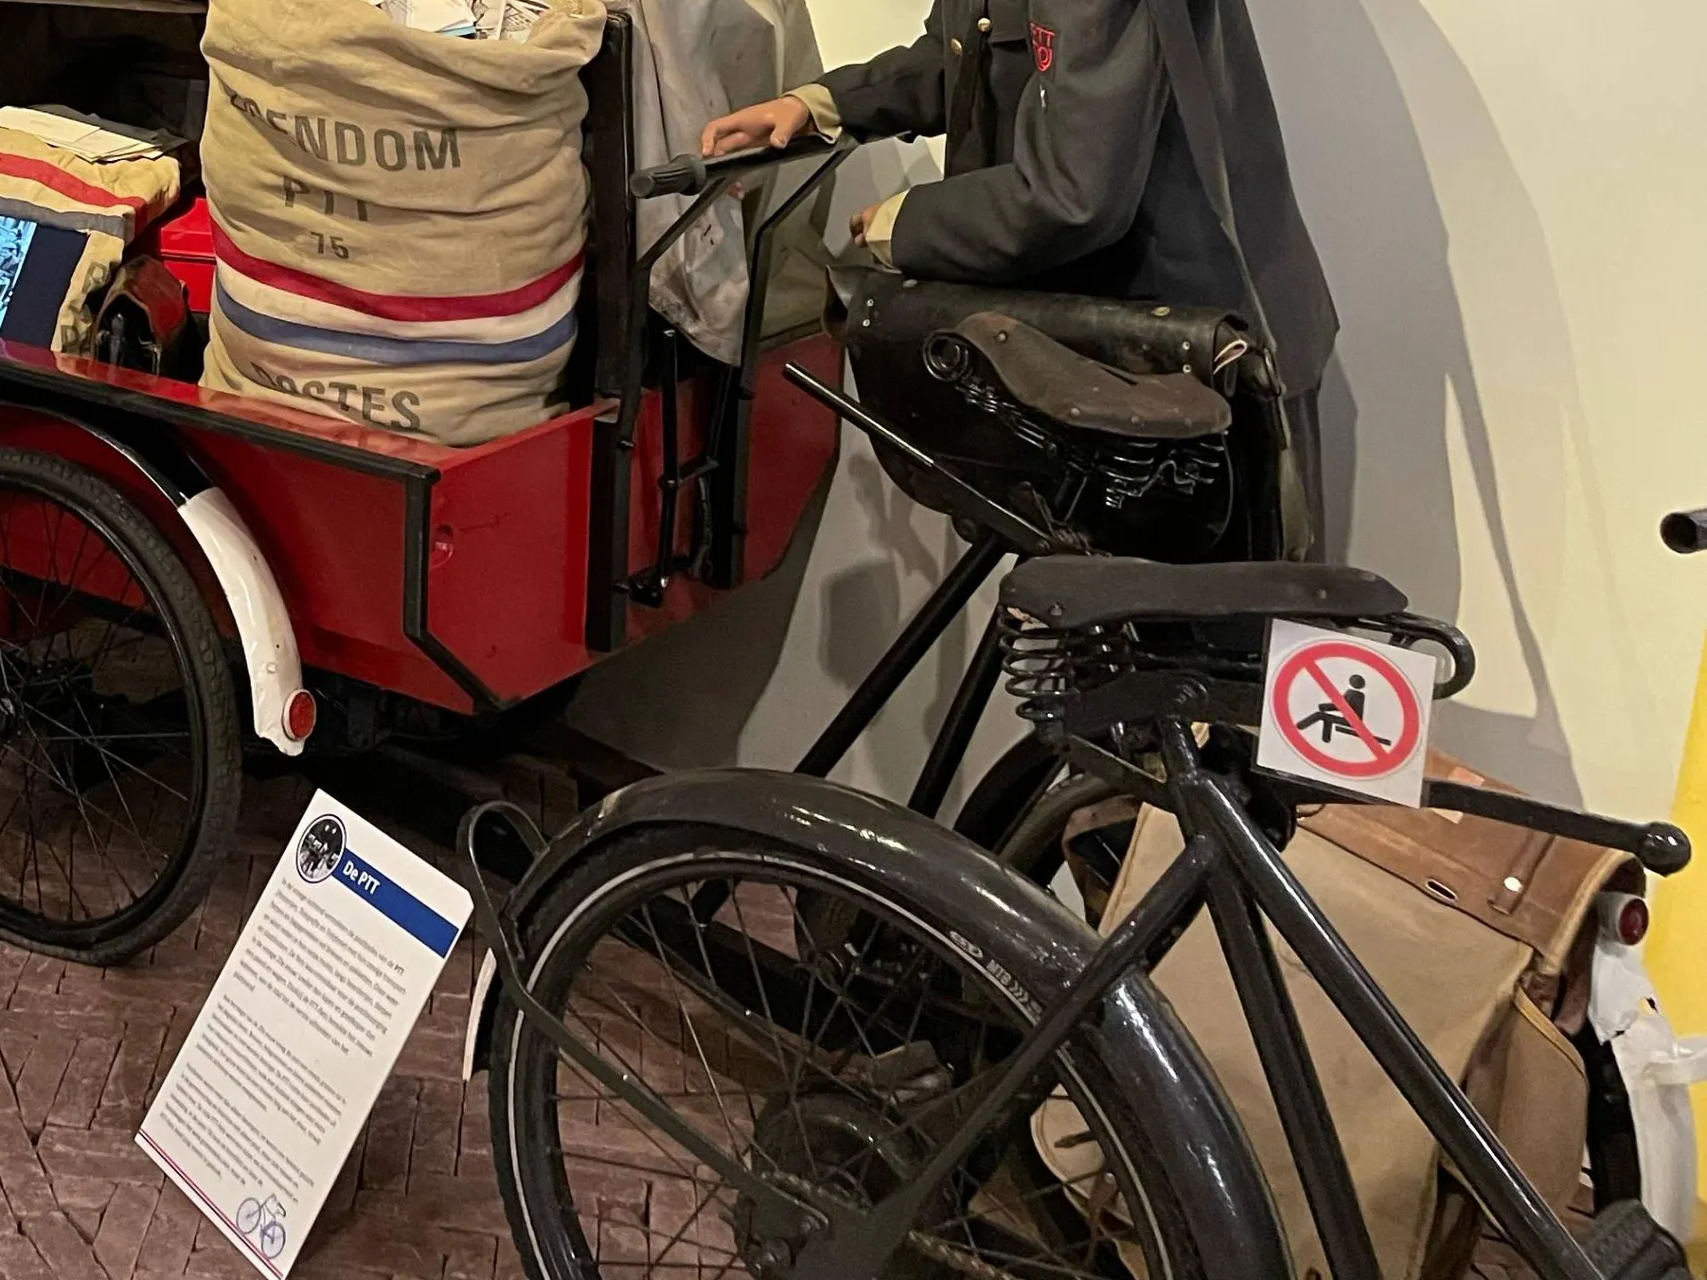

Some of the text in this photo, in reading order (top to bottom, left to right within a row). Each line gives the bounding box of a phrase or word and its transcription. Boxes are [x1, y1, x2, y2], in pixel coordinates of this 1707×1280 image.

[310, 231, 350, 260] 75
[342, 860, 381, 895] De PTT
